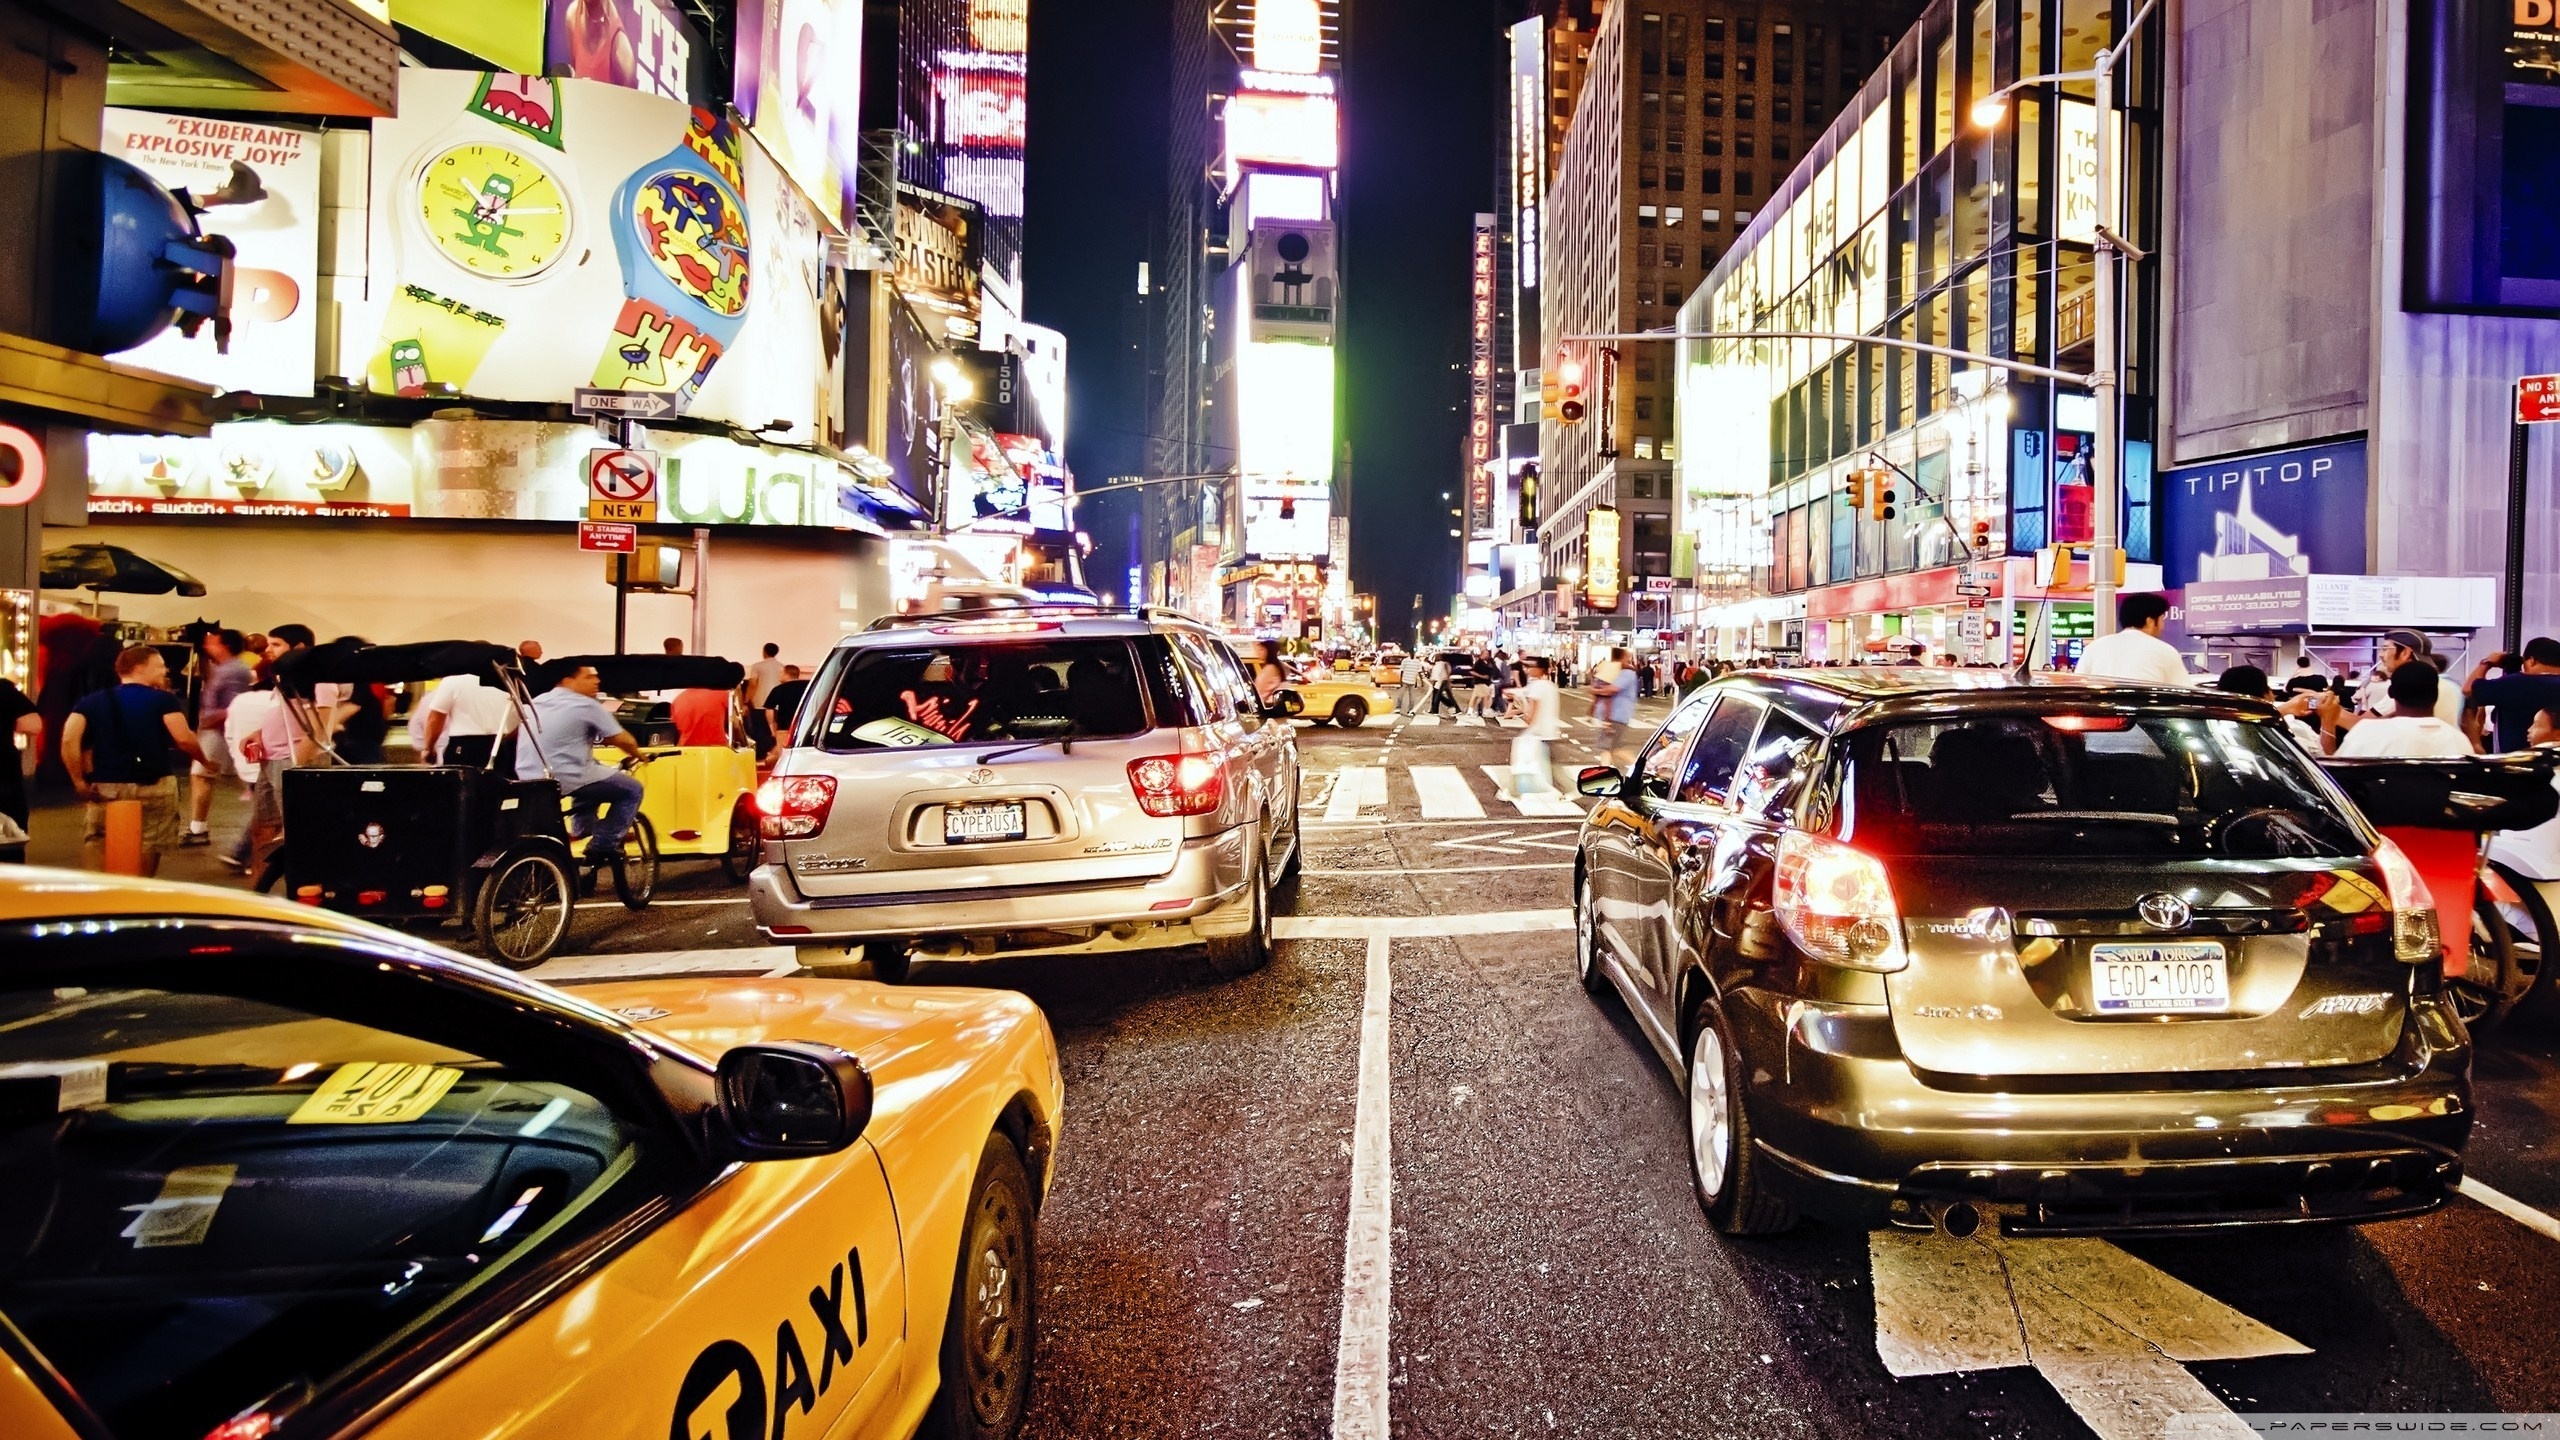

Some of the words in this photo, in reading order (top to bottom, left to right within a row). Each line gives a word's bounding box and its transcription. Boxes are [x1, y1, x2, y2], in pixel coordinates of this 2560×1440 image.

[125, 133, 235, 160] EXPLOSIVE
[143, 154, 157, 164] The
[159, 156, 176, 166] New
[179, 158, 198, 169] York
[202, 161, 225, 171] Times
[1523, 173, 1535, 208] FOR
[1804, 199, 1834, 257] THE
[1474, 235, 1490, 339] ERNST
[2526, 382, 2542, 392] NO
[589, 396, 618, 408] ONE
[632, 399, 661, 410] WAY
[1473, 398, 1489, 505] YOUNG
[603, 504, 643, 517] NEW
[589, 533, 626, 541] ANYTIME
[596, 526, 632, 534] STANDING
[2191, 594, 2224, 604] OFFICE
[2225, 590, 2301, 602] AVAILABILITIES
[2191, 604, 2216, 612] FROM
[2281, 600, 2301, 608] RSF
[952, 814, 1018, 834] CYPERUSA
[2124, 948, 2155, 961] NEW
[2159, 947, 2191, 961] YORK
[2108, 965, 2146, 996] EGD
[2164, 964, 2215, 995] 1008
[2128, 1000, 2144, 1008] THE
[2145, 999, 2173, 1007] EMPIRE
[2173, 999, 2196, 1007] STATE
